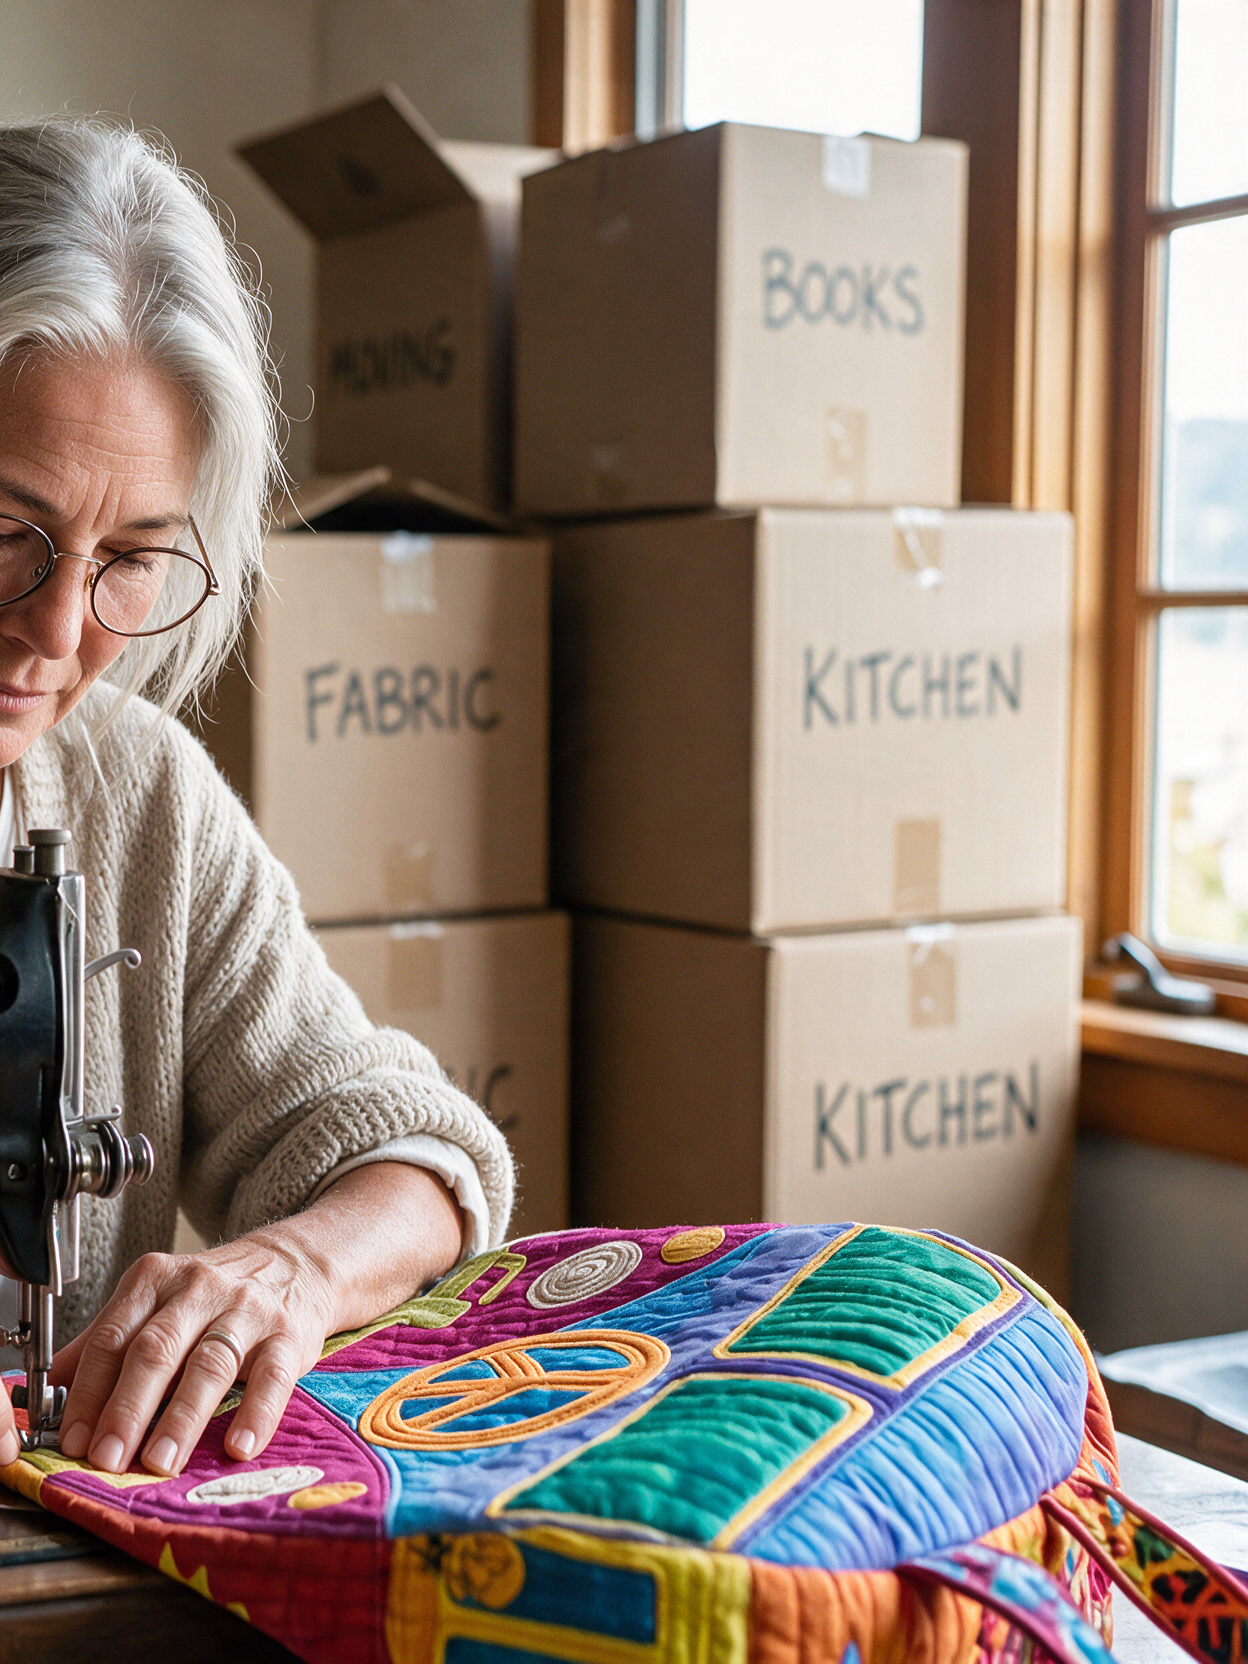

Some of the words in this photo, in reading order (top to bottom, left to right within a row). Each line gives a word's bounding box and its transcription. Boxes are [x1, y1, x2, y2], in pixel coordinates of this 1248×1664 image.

[762, 248, 925, 335] BOOKS
[304, 662, 503, 743] FABRIC
[802, 646, 1022, 731] KITCHEN
[814, 1063, 1039, 1172] KITCHEN
